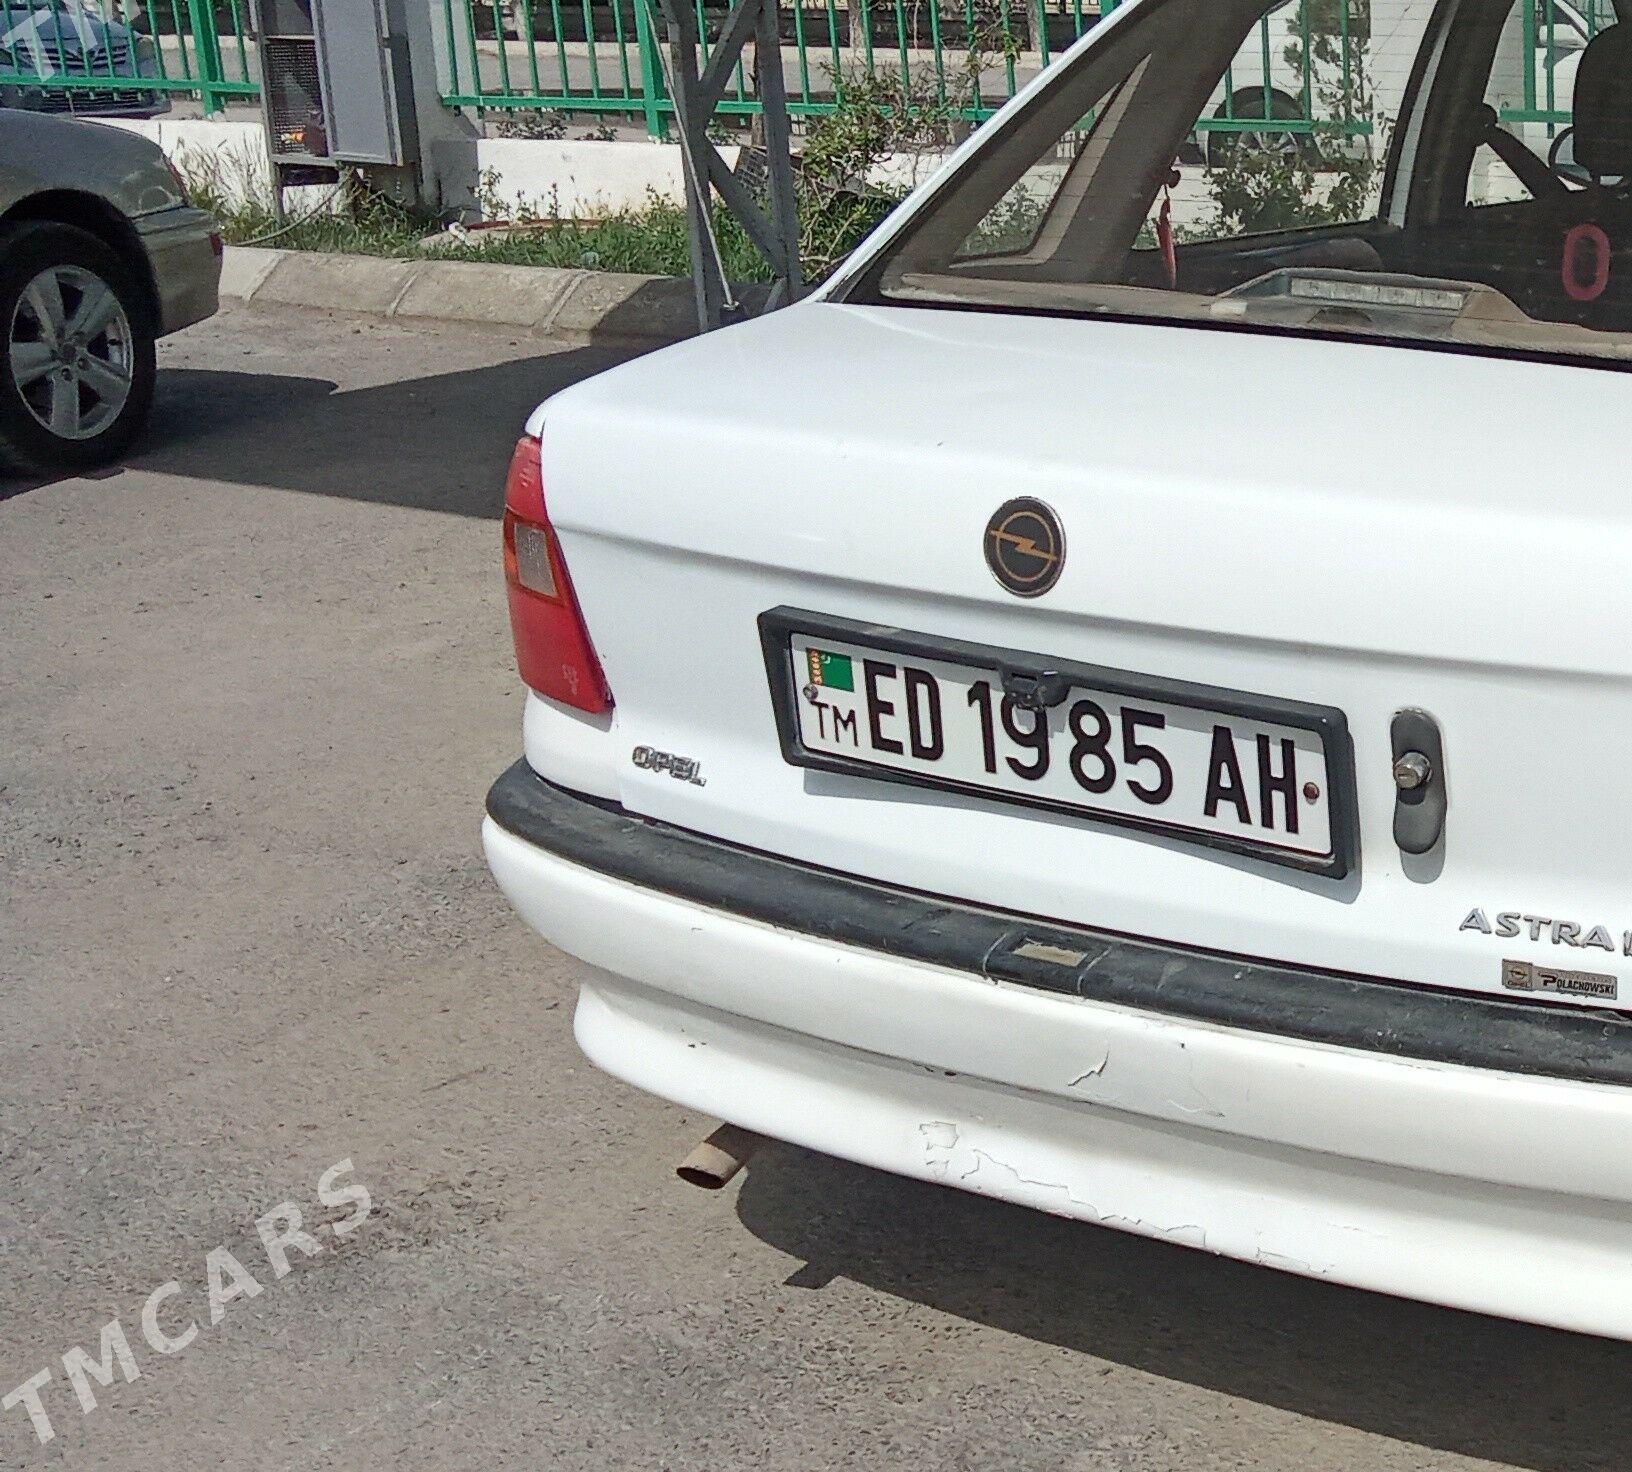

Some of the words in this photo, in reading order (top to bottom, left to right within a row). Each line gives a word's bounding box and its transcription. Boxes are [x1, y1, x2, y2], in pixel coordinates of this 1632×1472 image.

[811, 700, 860, 748] TM
[863, 659, 944, 762] ED
[967, 680, 1174, 805] 1985
[1203, 724, 1300, 834] AH
[632, 745, 707, 787] OPEL
[1459, 907, 1615, 952] ASTRA
